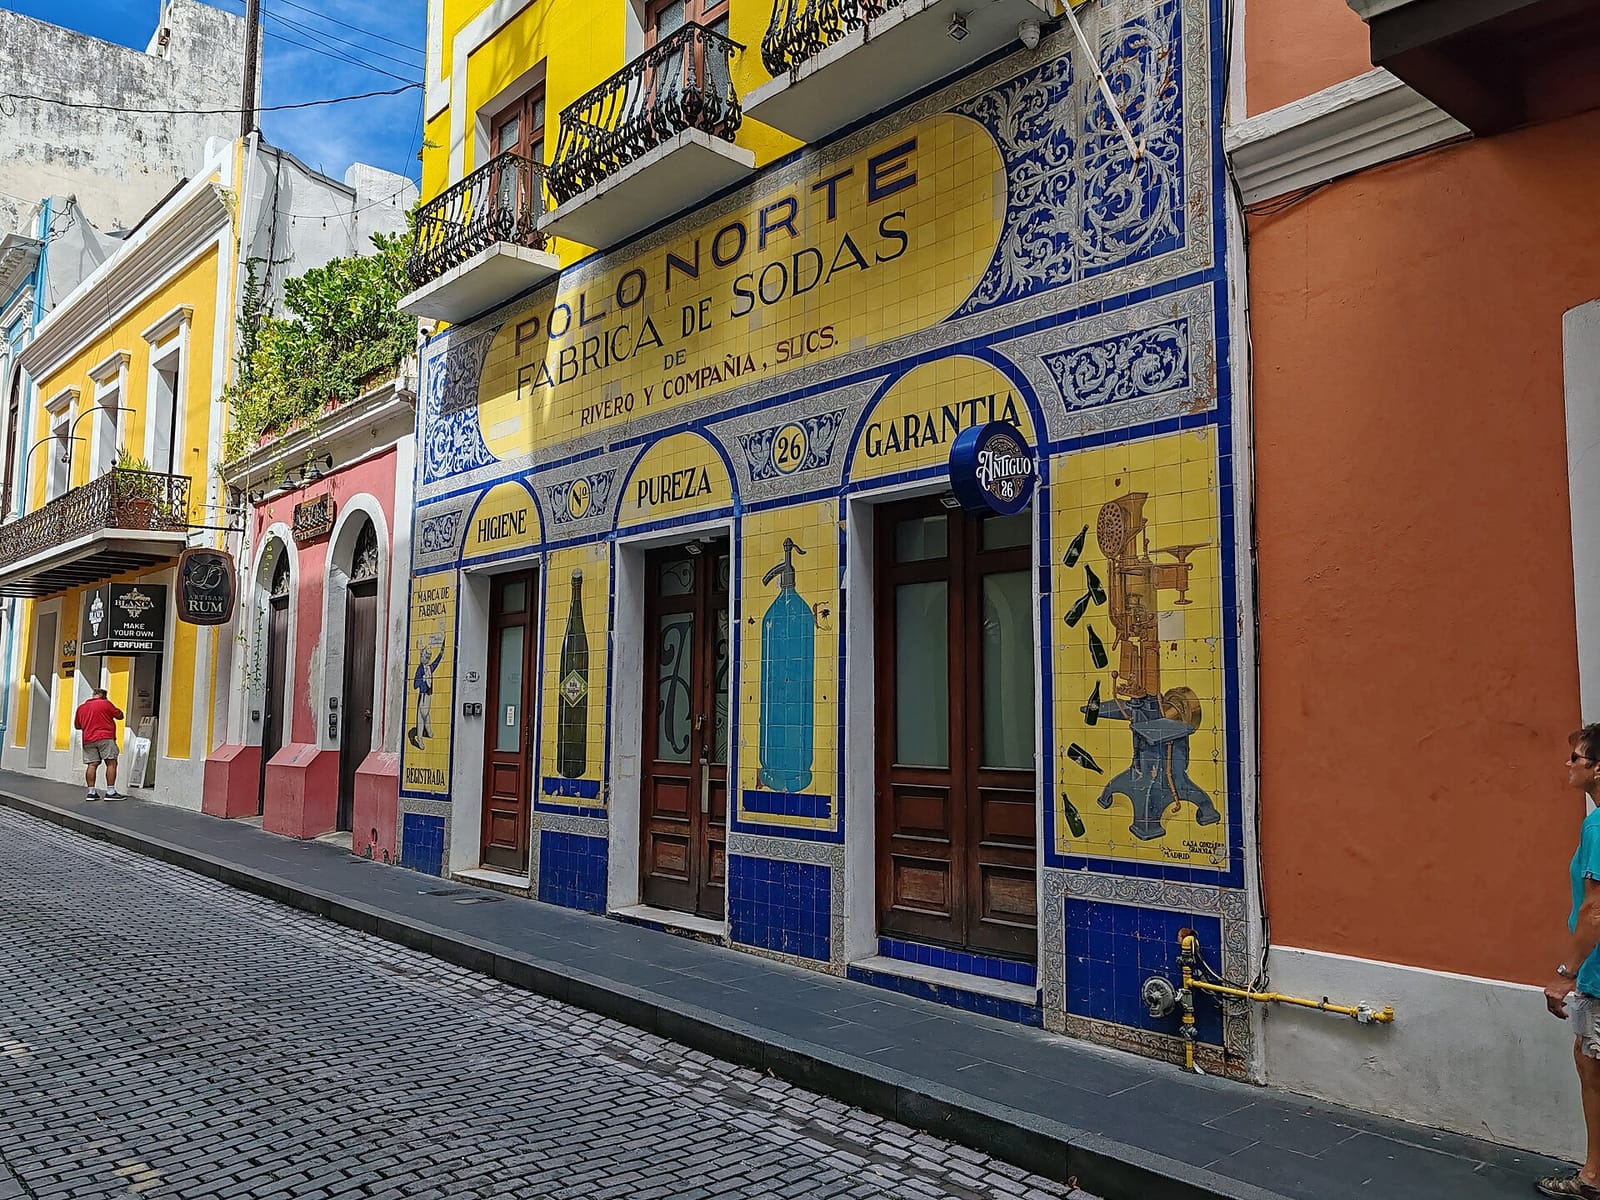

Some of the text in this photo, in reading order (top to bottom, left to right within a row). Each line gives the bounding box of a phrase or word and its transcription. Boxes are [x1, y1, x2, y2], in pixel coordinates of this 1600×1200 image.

[514, 136, 919, 357] POLO NORTE
[516, 210, 908, 400] FABRICA DE SODAS
[663, 348, 687, 370] DE
[580, 392, 635, 427] RIVERO
[644, 385, 654, 406] Y
[775, 325, 840, 364] SUCS.
[865, 390, 1021, 458] GARANTIA
[777, 432, 801, 464] 26
[637, 466, 712, 508] PUREZA
[1001, 480, 1014, 498] 26
[477, 509, 527, 543] HIGIENE
[417, 586, 450, 603] MARCA DE
[114, 600, 155, 608] BLANCA
[188, 600, 223, 612] RUM
[418, 602, 447, 617] FABRICA
[113, 629, 154, 638] YOUR OWN
[123, 622, 146, 630] MAKE
[112, 641, 154, 649] PERFUME!
[405, 767, 446, 786] REGISTRADA
[1164, 850, 1190, 860] MADRID
